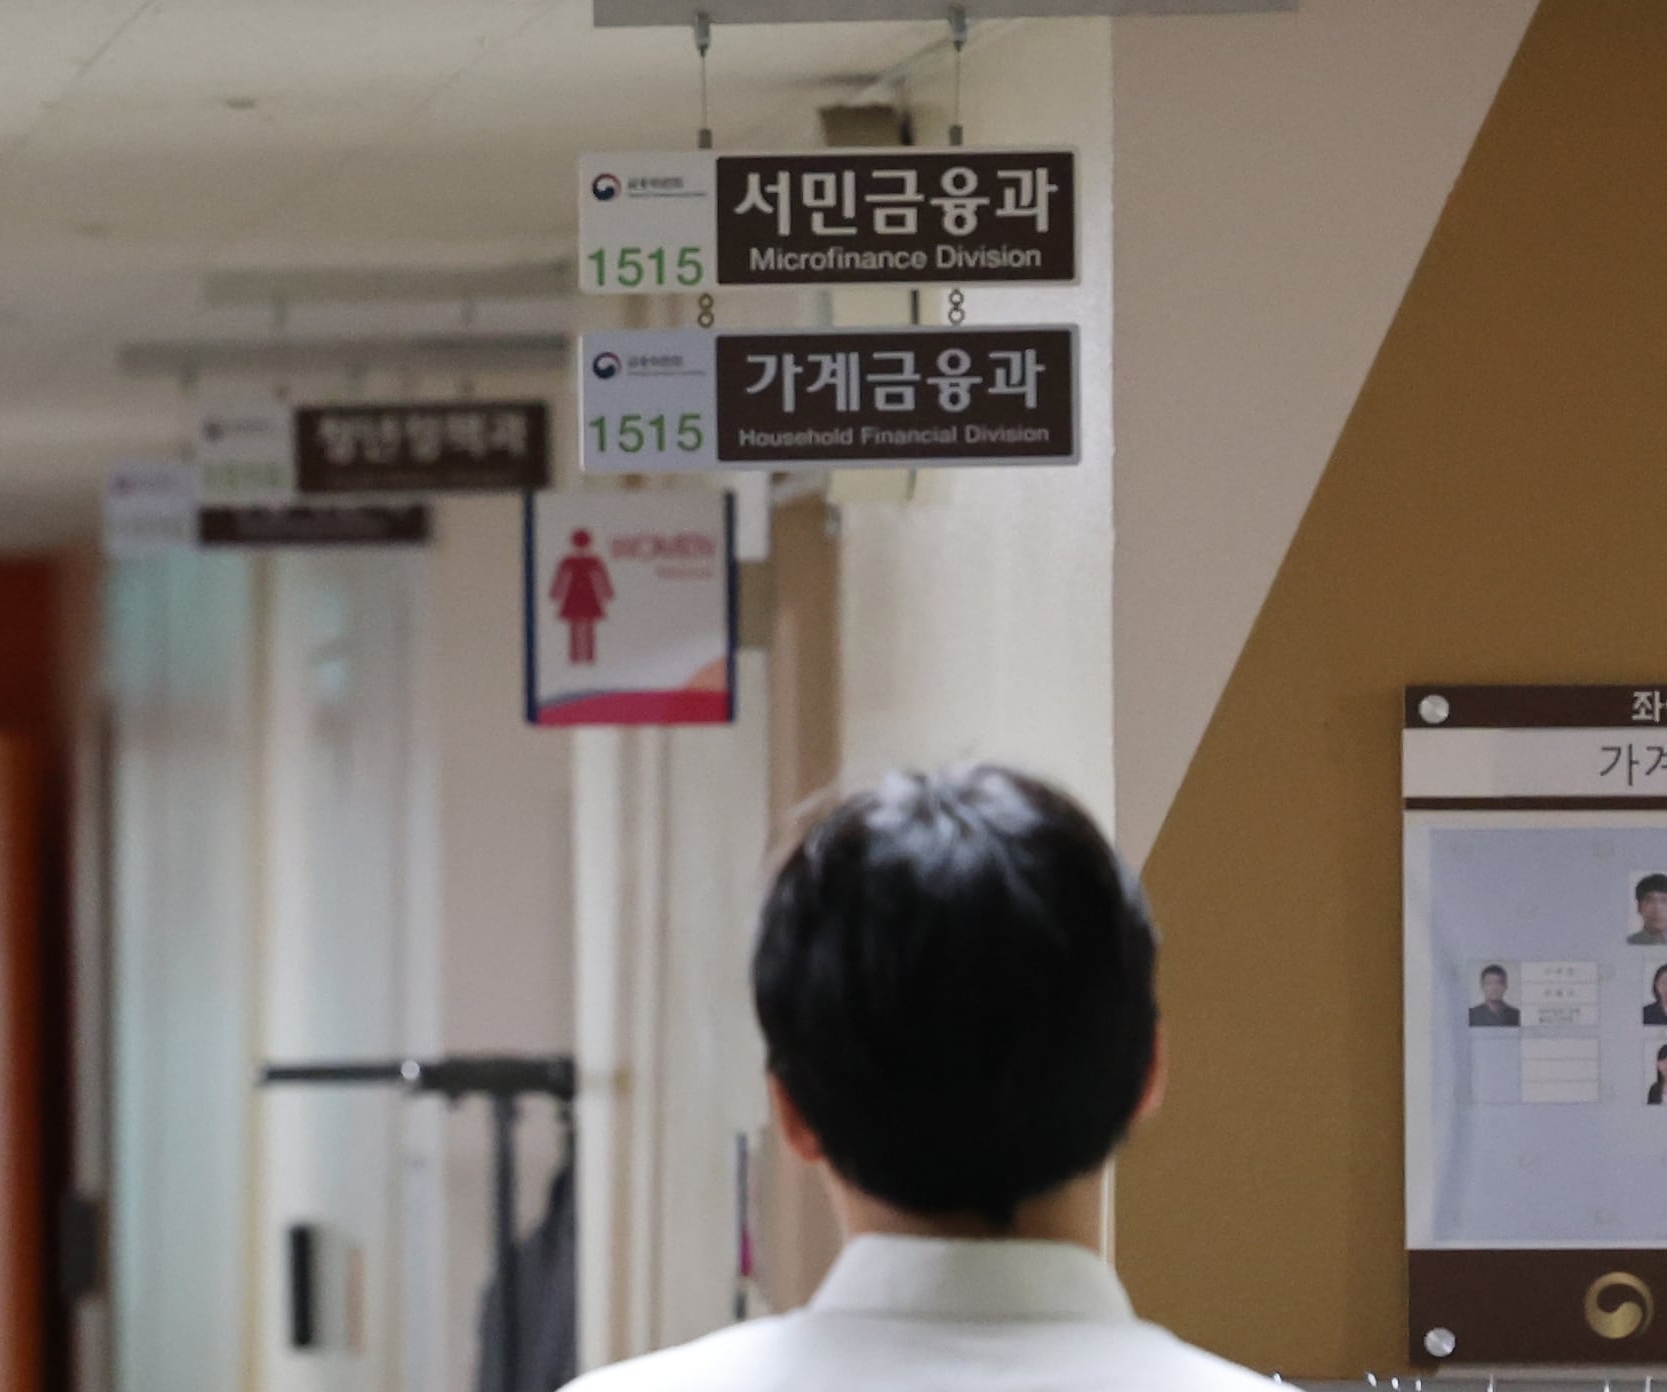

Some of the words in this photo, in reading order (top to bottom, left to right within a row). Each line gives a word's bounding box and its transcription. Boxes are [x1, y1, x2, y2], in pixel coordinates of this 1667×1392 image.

[733, 166, 1059, 237] 서민금융과
[588, 246, 705, 287] 1515
[748, 246, 928, 272] Microfinance
[935, 244, 1043, 269] Division
[745, 347, 1046, 414] 가계금융과
[588, 413, 705, 453] 1515
[738, 427, 854, 448] Household
[860, 425, 959, 446] Financial
[964, 423, 1051, 444] Division
[1631, 690, 1667, 723] 좌
